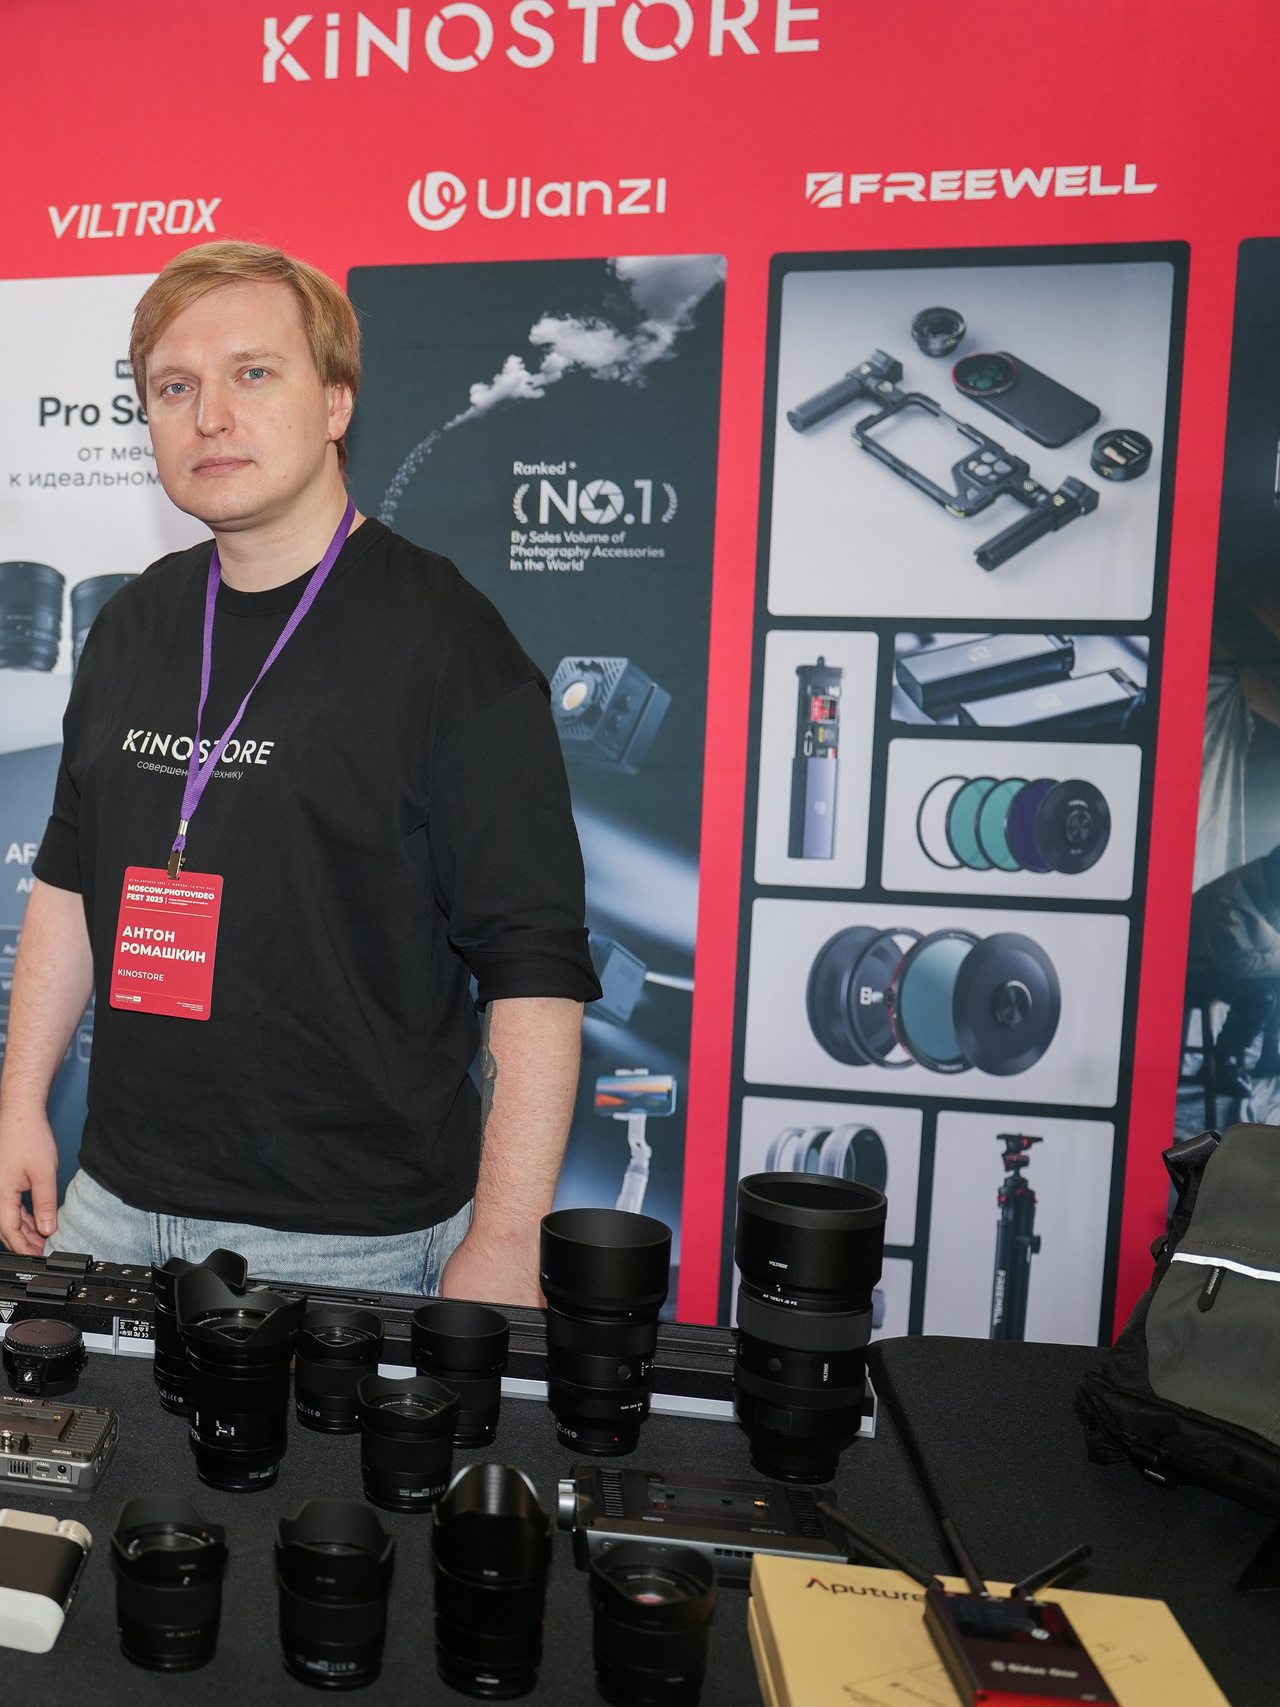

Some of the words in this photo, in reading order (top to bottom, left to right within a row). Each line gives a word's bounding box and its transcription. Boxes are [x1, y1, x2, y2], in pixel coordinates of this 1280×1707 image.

[849, 163, 1157, 203] FREEWELL
[47, 197, 222, 239] VILTROX
[39, 396, 101, 427] Pro
[78, 447, 104, 462] от
[513, 460, 566, 475] Ranked
[9, 473, 22, 488] к
[539, 478, 653, 525] NO.1
[511, 530, 528, 545] By
[528, 530, 562, 543] Sales
[563, 530, 610, 543] Volume
[611, 529, 627, 543] of
[510, 545, 591, 560] Photography
[592, 546, 666, 558] Accessories
[524, 558, 545, 571] the
[546, 559, 585, 571] World
[122, 728, 275, 765] KiNOSORE
[126, 893, 145, 901] FEST
[145, 895, 164, 903] 2025
[127, 884, 215, 900] MOSCOW.PHOTOVIDEO
[122, 925, 175, 942] АНТОН
[120, 941, 206, 963] РОМАШКИН
[117, 968, 164, 982] KINOSTORE
[768, 1260, 789, 1269] VILTROX
